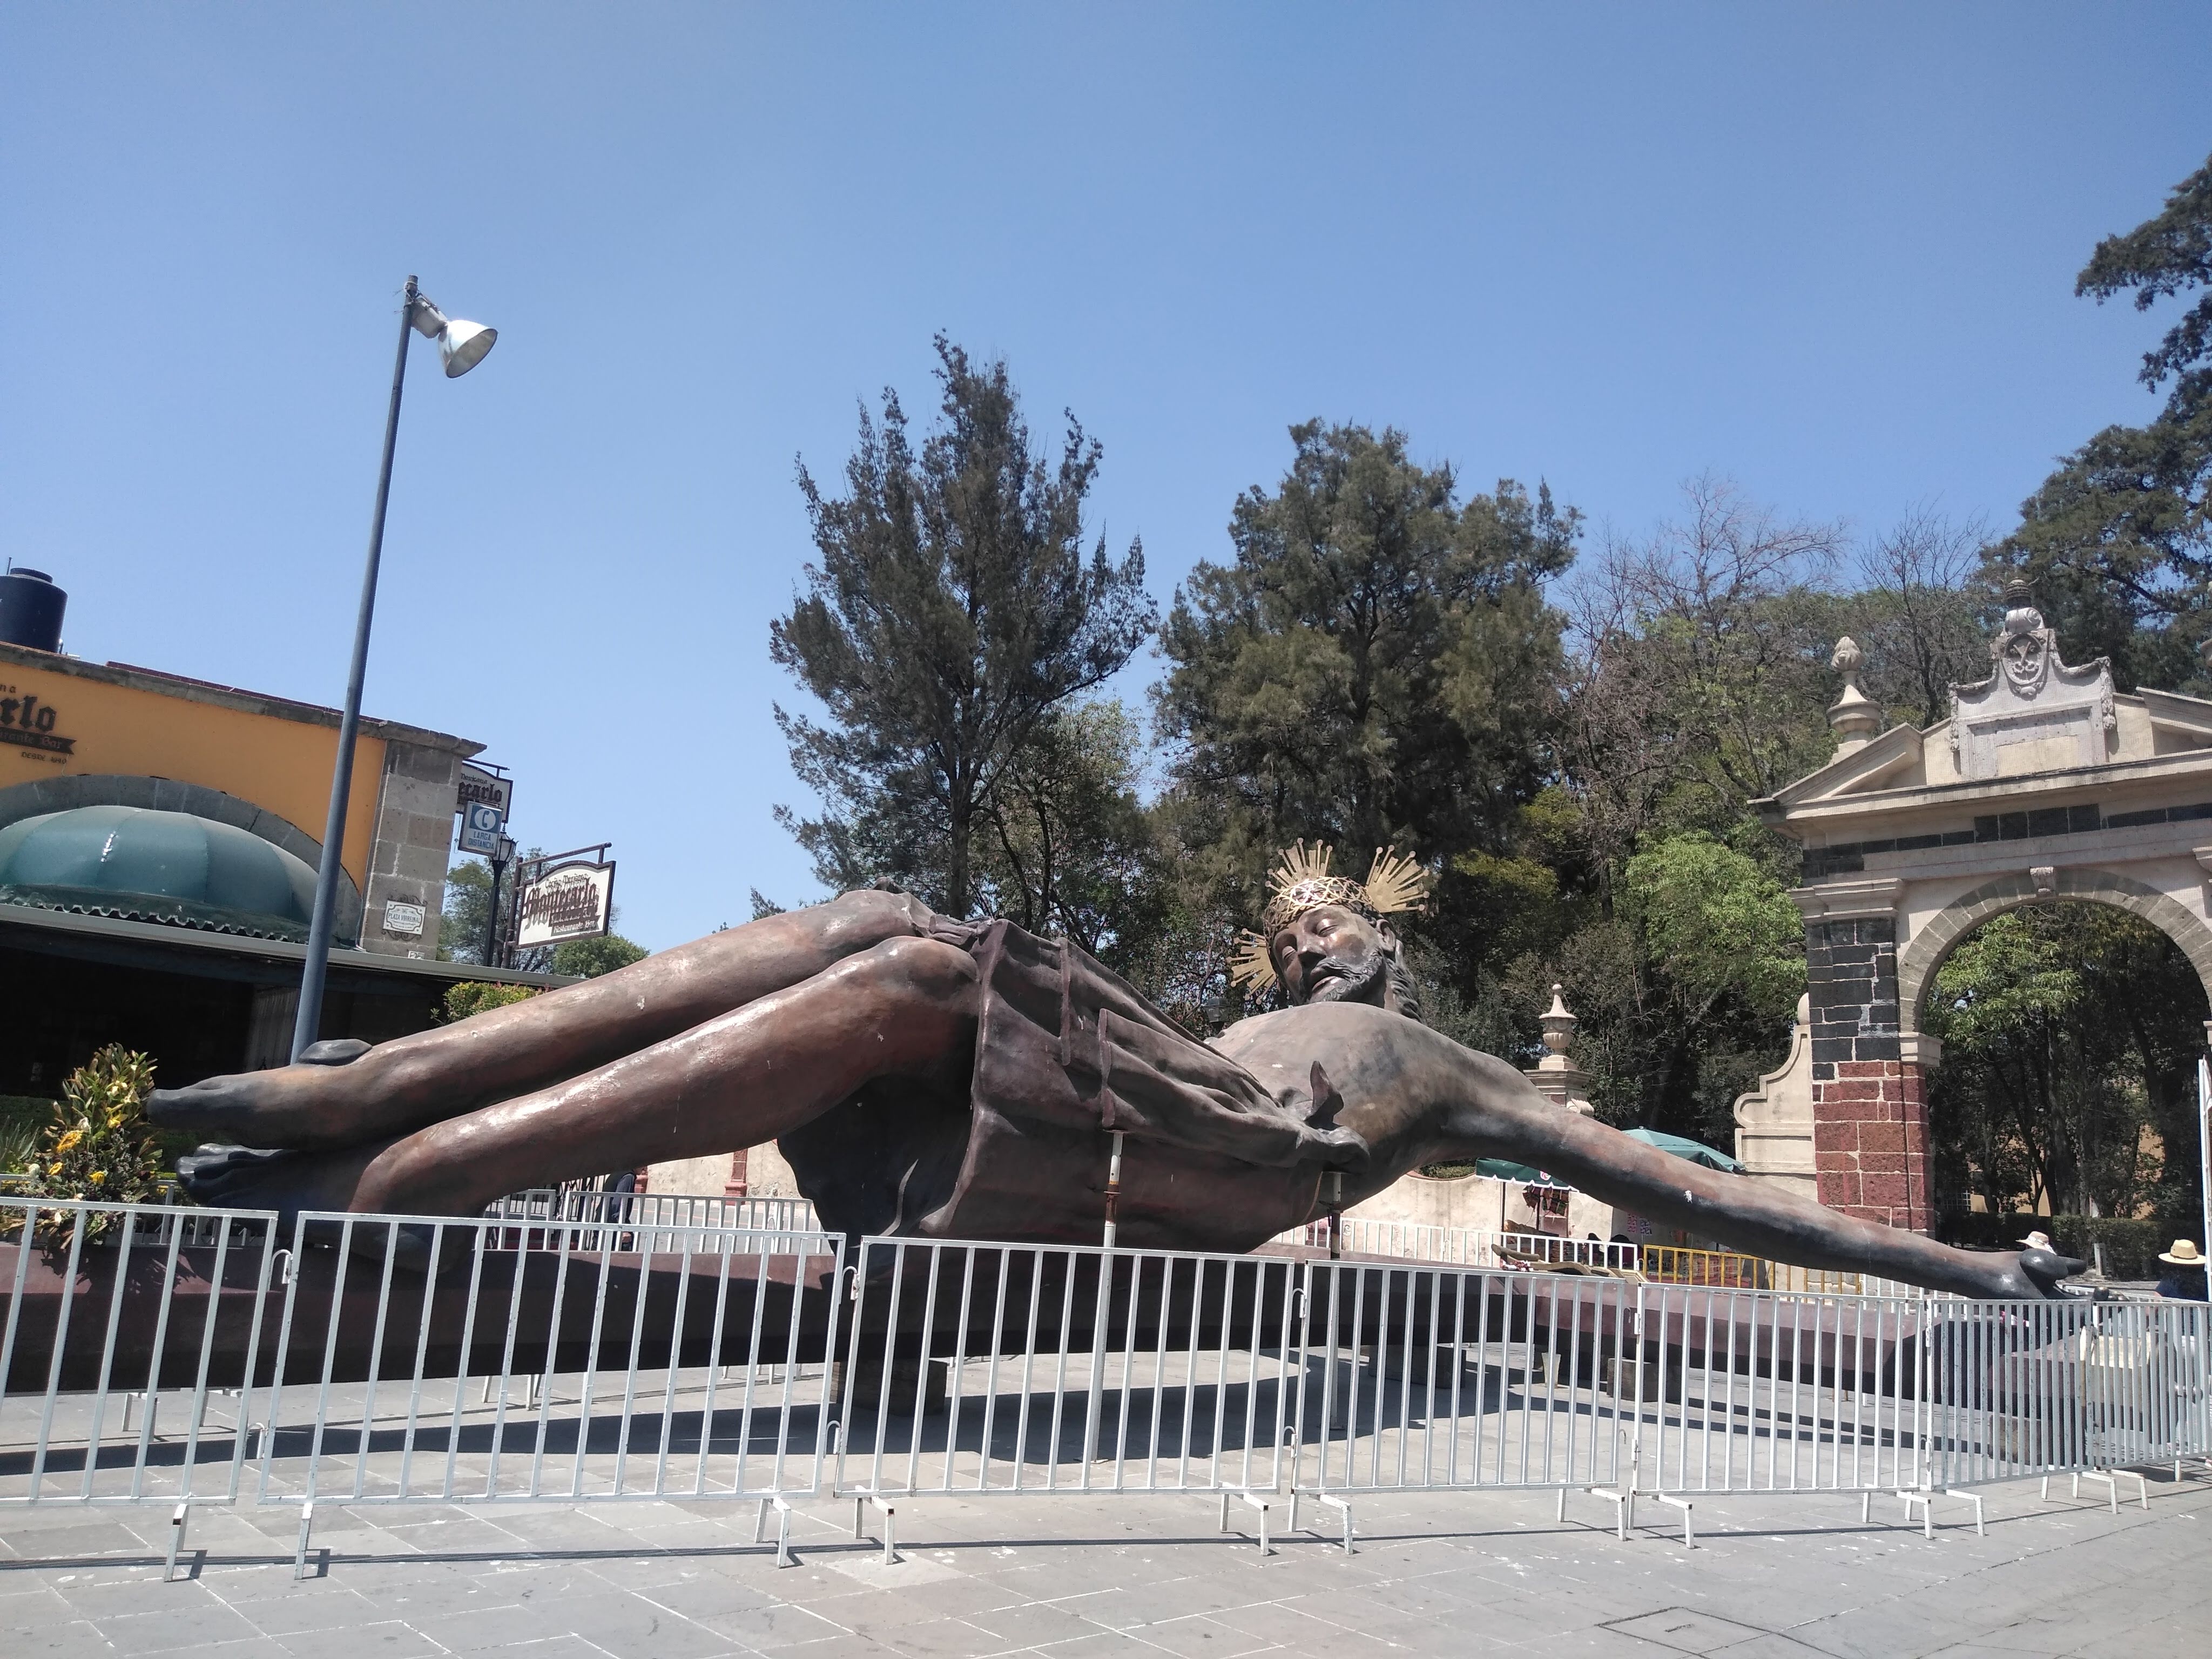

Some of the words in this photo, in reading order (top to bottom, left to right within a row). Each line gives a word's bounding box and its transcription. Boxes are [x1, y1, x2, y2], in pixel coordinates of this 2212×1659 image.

[42, 736, 62, 748] Bar
[21, 751, 46, 761] DESDE
[474, 831, 491, 841] LARGA
[468, 838, 494, 849] DISTANCIA
[522, 876, 599, 920] Montecarlo
[401, 914, 421, 923] VIRREINAL
